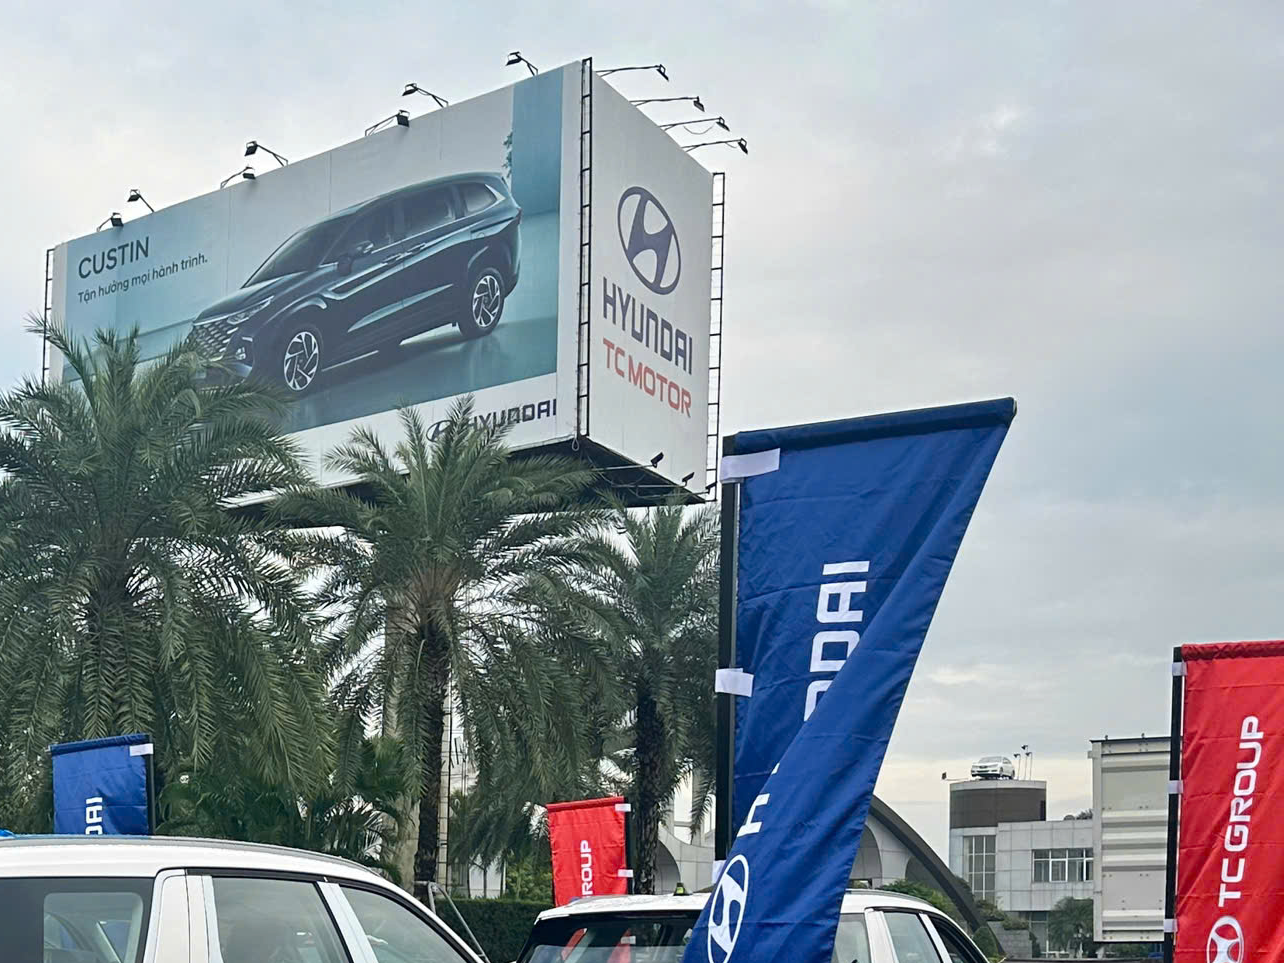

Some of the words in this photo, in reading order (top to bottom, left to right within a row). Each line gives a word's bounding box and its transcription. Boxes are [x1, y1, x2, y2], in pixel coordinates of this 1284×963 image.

[78, 236, 150, 279] CUSTIN
[131, 269, 151, 287] mọi
[152, 261, 179, 281] hành
[181, 253, 209, 271] trình.
[603, 276, 693, 375] HYUNDAI
[603, 337, 626, 378] TC
[628, 355, 693, 418] MOTOR
[1224, 715, 1265, 852] GROUP
[1218, 857, 1245, 907] TC
